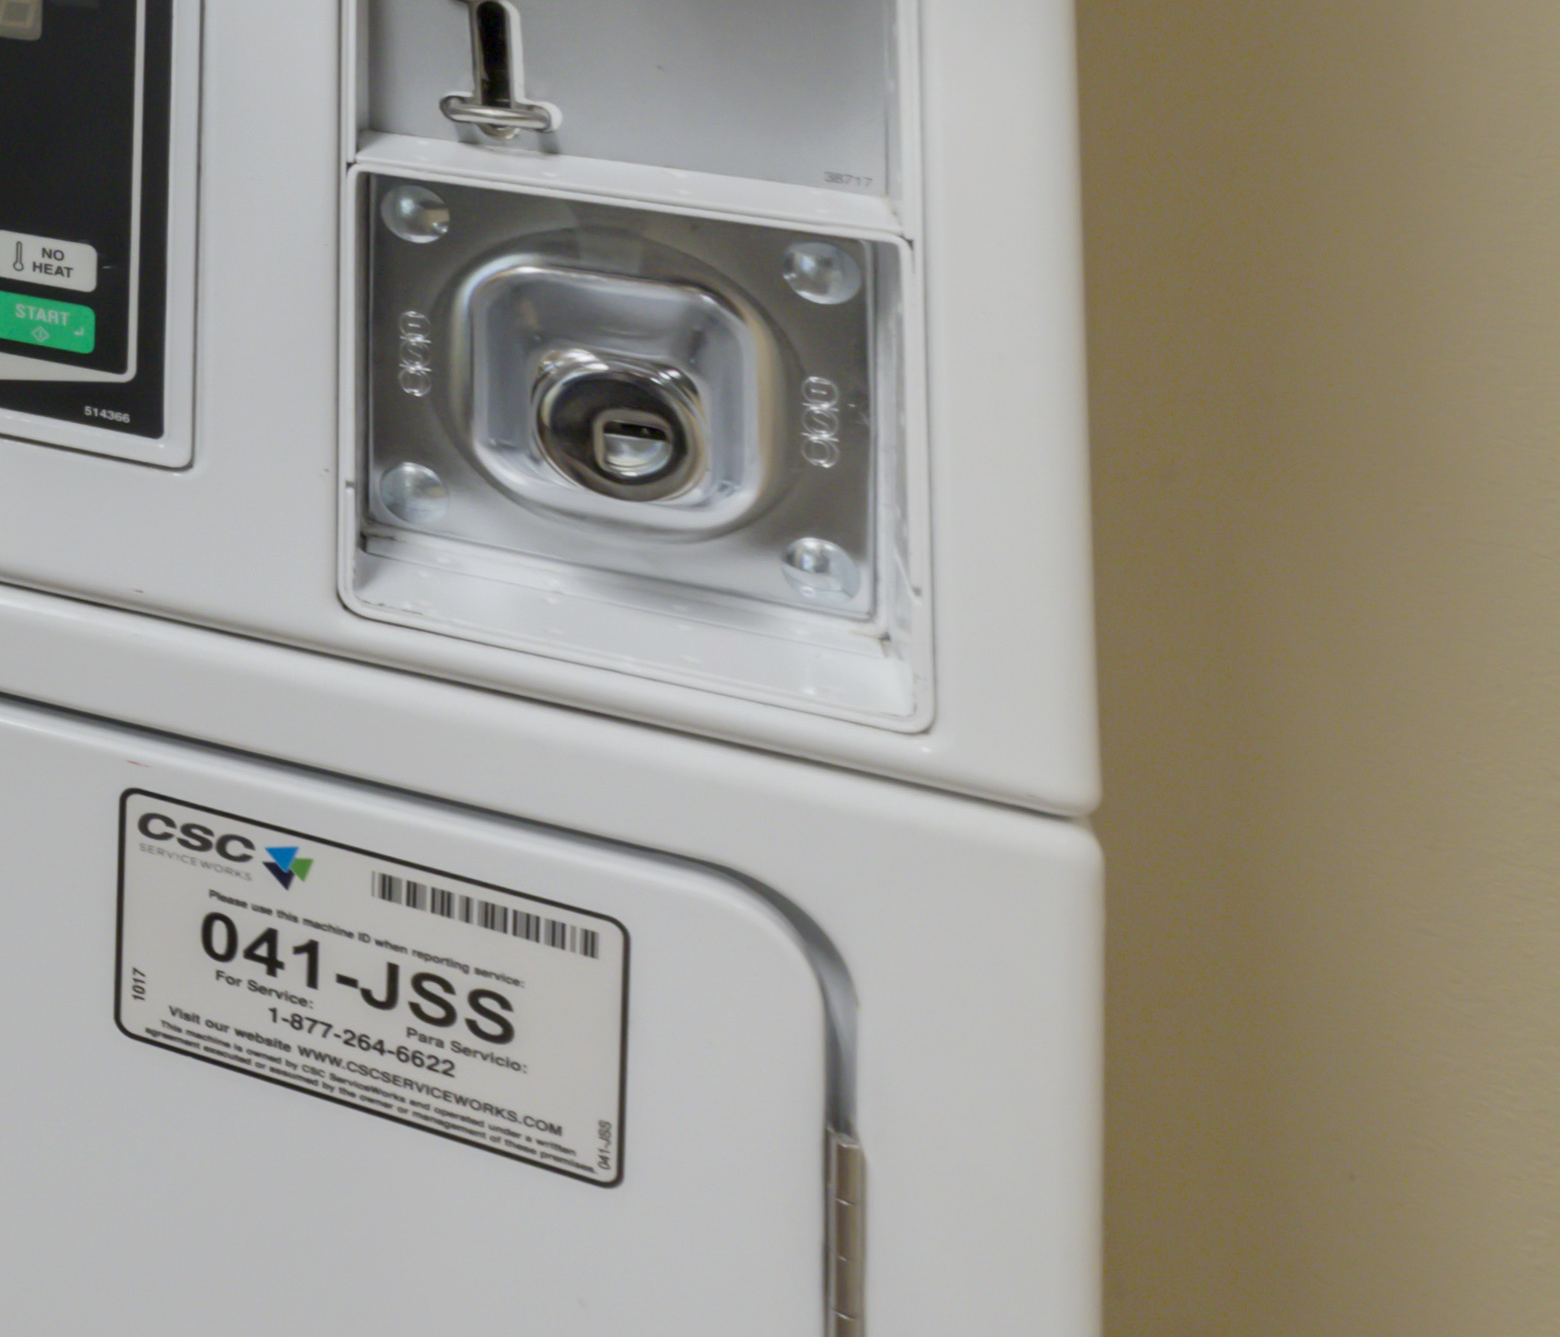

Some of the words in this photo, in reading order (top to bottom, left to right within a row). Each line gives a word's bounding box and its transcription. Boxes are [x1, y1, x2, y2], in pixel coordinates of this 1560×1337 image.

[31, 261, 75, 280] HEAT
[40, 247, 66, 263] NO
[14, 303, 71, 327] START
[83, 406, 131, 425] 514366
[137, 812, 256, 864] CSC
[138, 842, 253, 882] SERVICEWORKS
[199, 911, 516, 1046] 041-JSS
[215, 970, 244, 990] For
[247, 979, 314, 1010] Service:
[267, 1006, 457, 1079] 1-877-264-6622
[405, 1026, 446, 1050] Para
[450, 1039, 529, 1075] Servicio:
[168, 1004, 202, 1028] Visit
[204, 1016, 231, 1034] our
[233, 1024, 292, 1054] website
[297, 1044, 563, 1138] WWW.CSCSERVICEWORKS.COM
